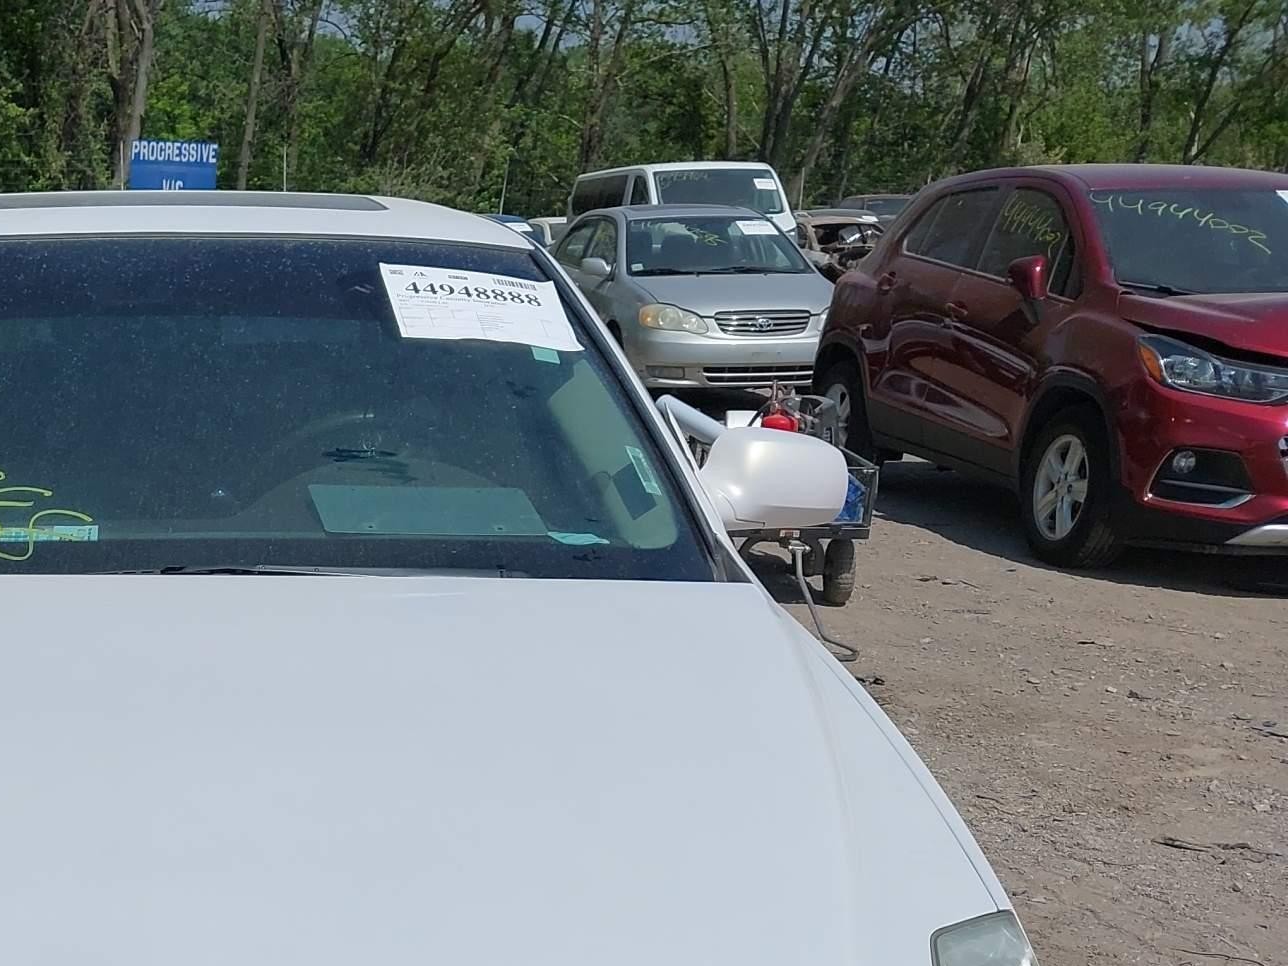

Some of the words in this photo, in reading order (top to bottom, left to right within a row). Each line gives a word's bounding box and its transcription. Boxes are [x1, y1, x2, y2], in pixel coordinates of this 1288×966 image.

[131, 141, 219, 163] PROGRESSIVE
[1089, 191, 1272, 254] 44944002
[404, 281, 542, 307] 44948888
